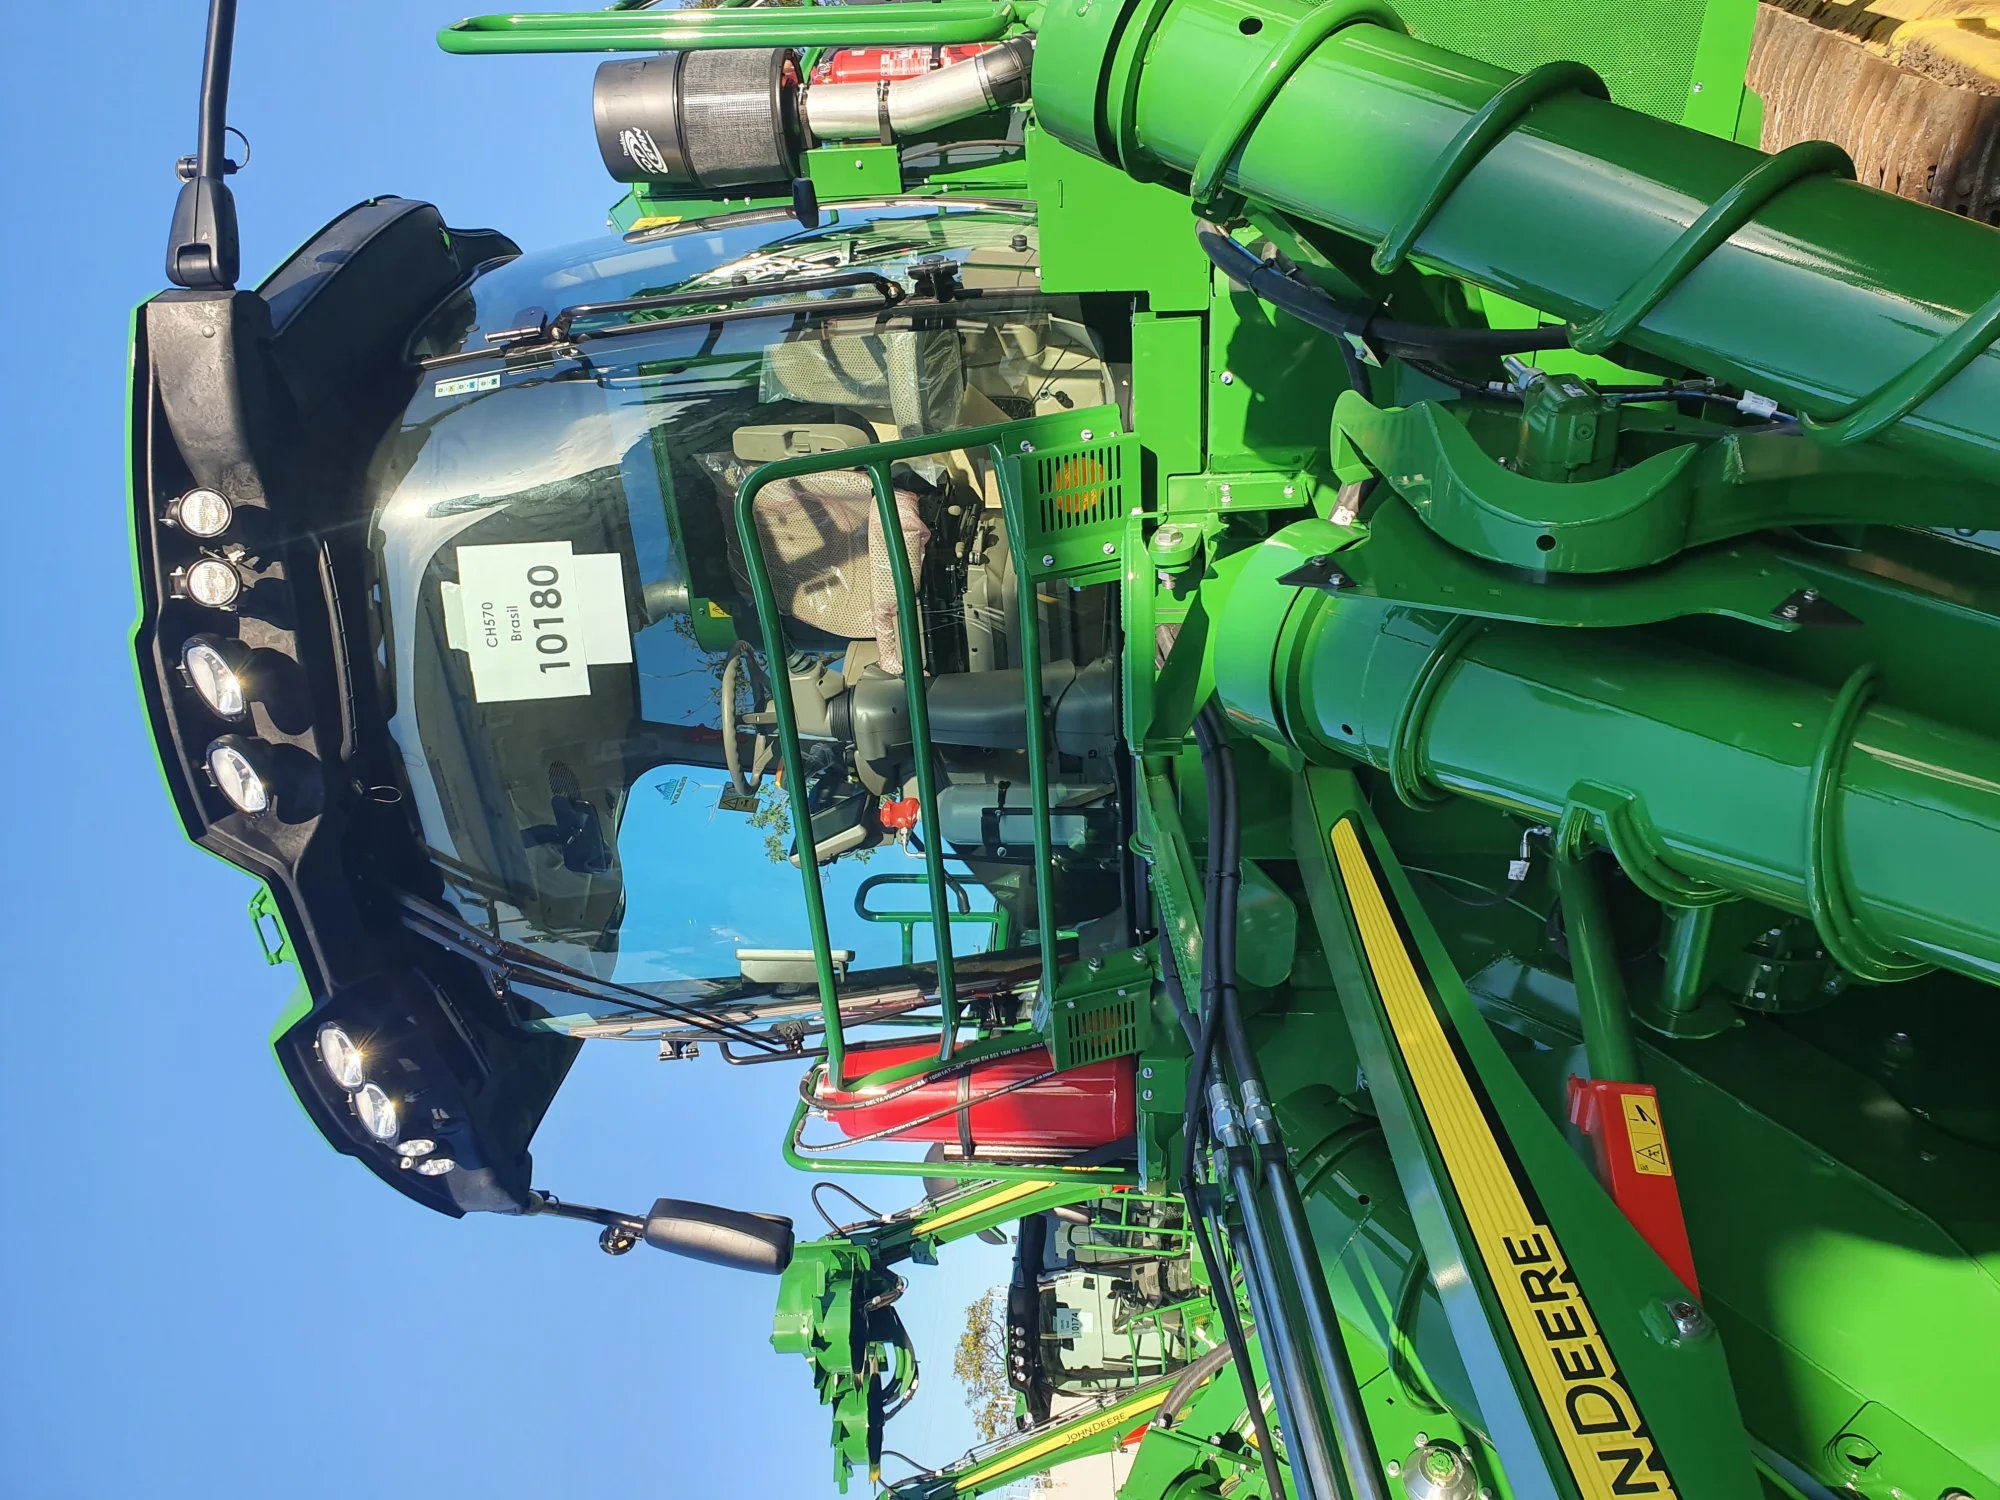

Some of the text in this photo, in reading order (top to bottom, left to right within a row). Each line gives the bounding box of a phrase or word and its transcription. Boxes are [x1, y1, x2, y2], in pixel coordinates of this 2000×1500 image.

[632, 126, 658, 161] SPIN
[634, 148, 659, 174] TOP
[481, 602, 498, 648] CH570
[506, 605, 522, 642] Brasil
[526, 565, 570, 674] 10180
[1071, 1312, 1080, 1334] 10174
[1502, 1232, 1632, 1435] DEERE
